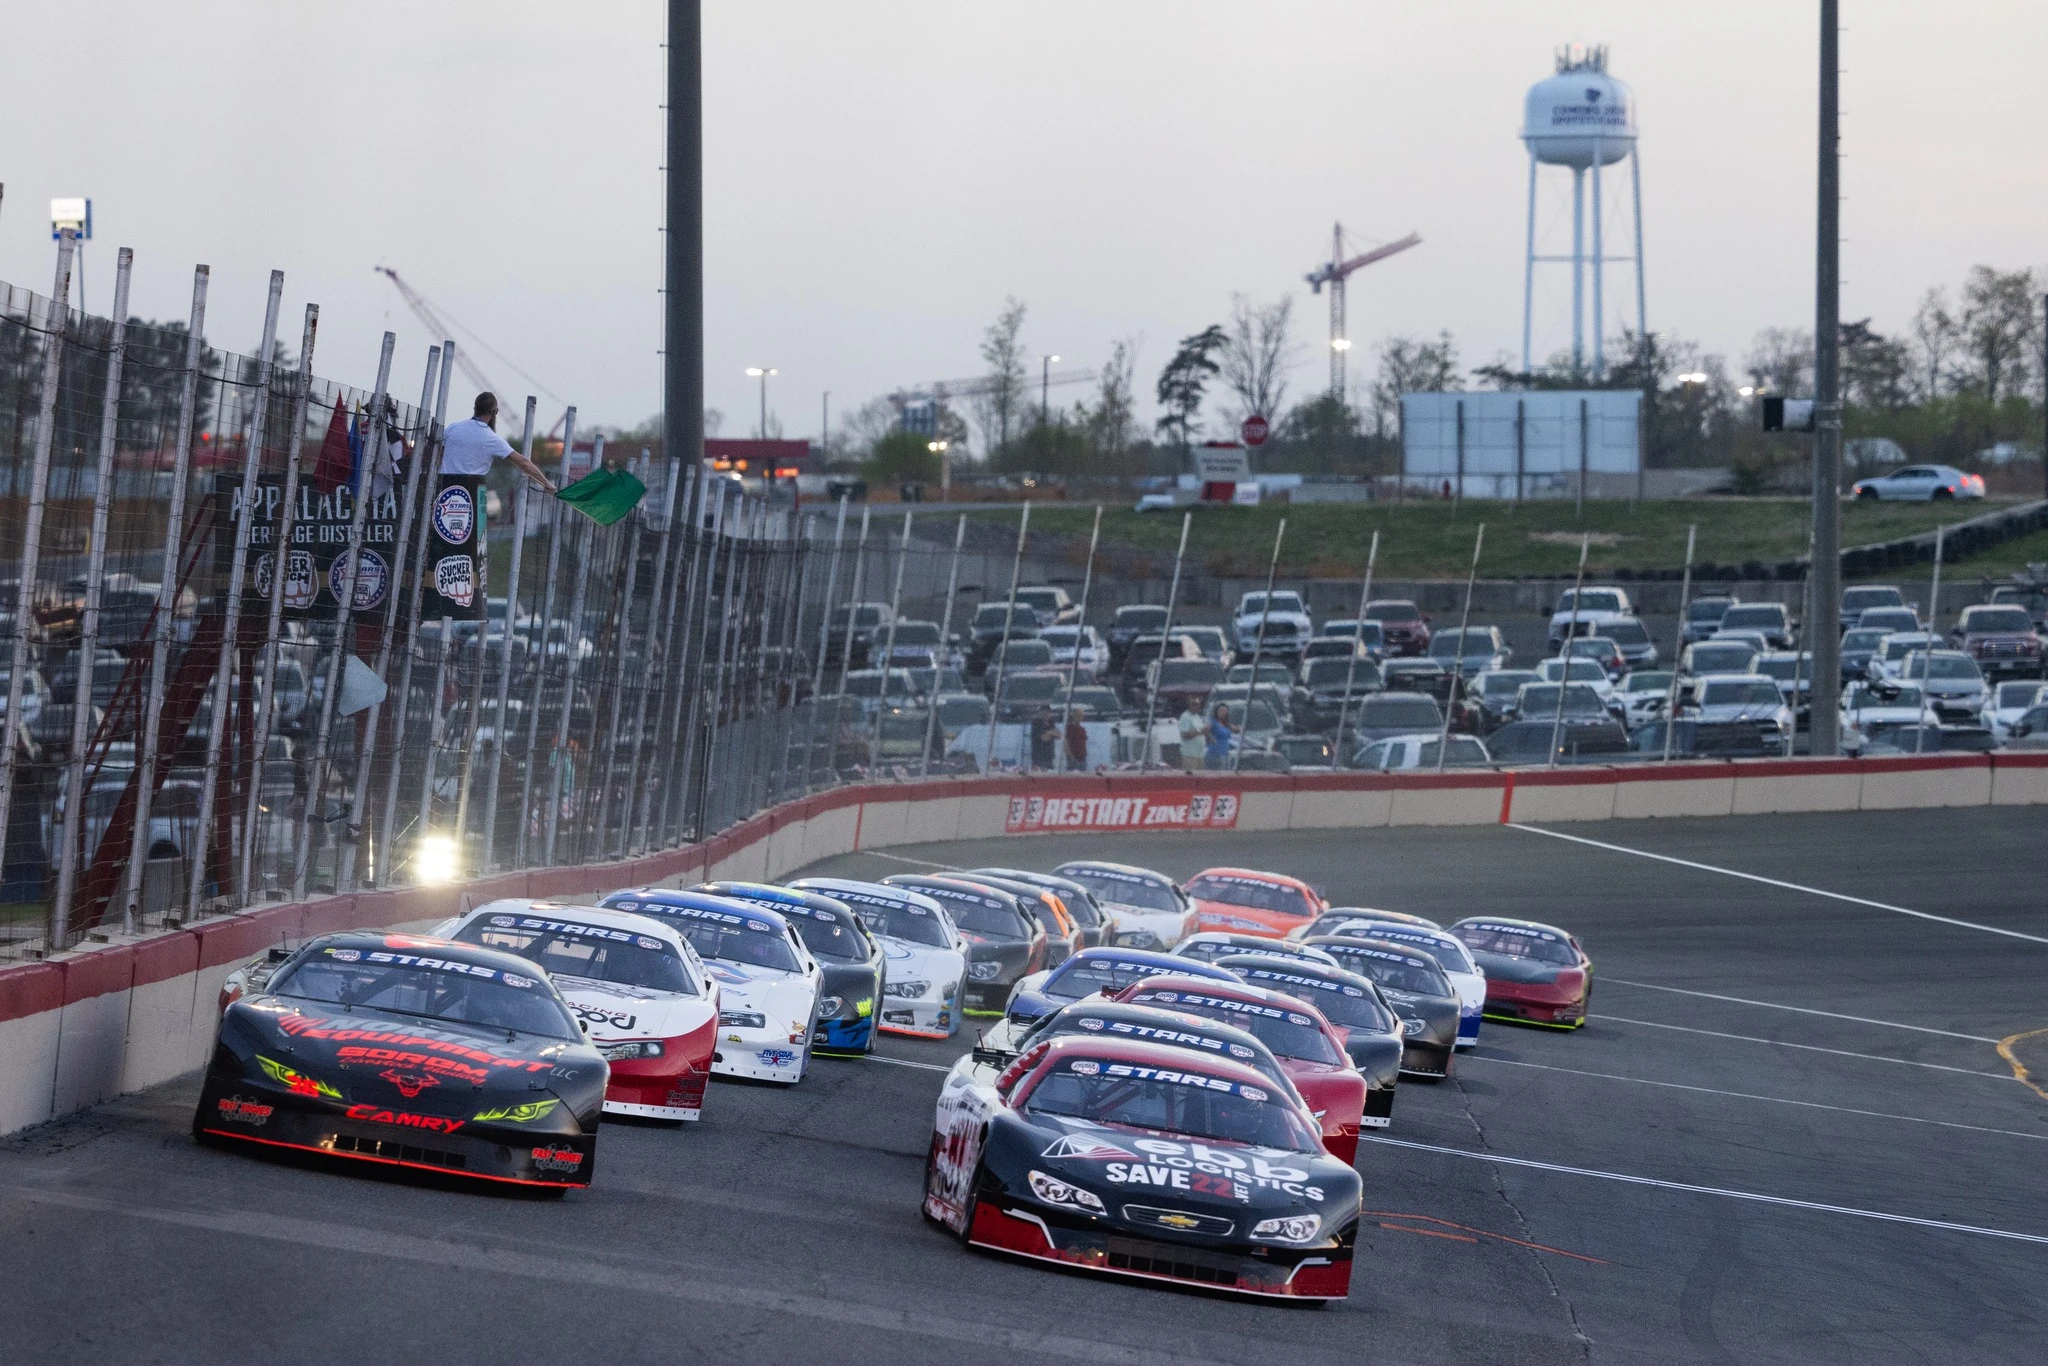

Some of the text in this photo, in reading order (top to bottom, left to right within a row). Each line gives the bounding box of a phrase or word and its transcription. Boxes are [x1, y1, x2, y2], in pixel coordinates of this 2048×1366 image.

[230, 485, 415, 521] APPLACIA
[440, 562, 470, 578] SUCKER
[440, 575, 470, 588] PUNCH
[1043, 798, 1188, 826] RESTART ZONE
[1080, 870, 1142, 883] STARS
[824, 890, 904, 909] STARS
[909, 886, 982, 903] STARS
[643, 904, 743, 924] STARS
[519, 919, 632, 942] STARS
[1369, 930, 1437, 945] STARS
[1480, 925, 1540, 937] STARS
[1329, 946, 1404, 961] STARS
[367, 952, 497, 978] STARS
[1253, 969, 1338, 991] STARS
[567, 1001, 628, 1018] ACING
[1183, 995, 1283, 1018] STARS
[318, 1018, 521, 1057] NORTEC
[1109, 1023, 1223, 1049] STARS
[301, 1029, 579, 1081] EQUIPMENT LLC
[763, 1049, 777, 1058] FIVE
[1104, 1064, 1233, 1092] STARS
[345, 1104, 466, 1134] CAMRY
[1133, 1138, 1310, 1183] ebb
[1148, 1154, 1325, 1202] LOGISTICS
